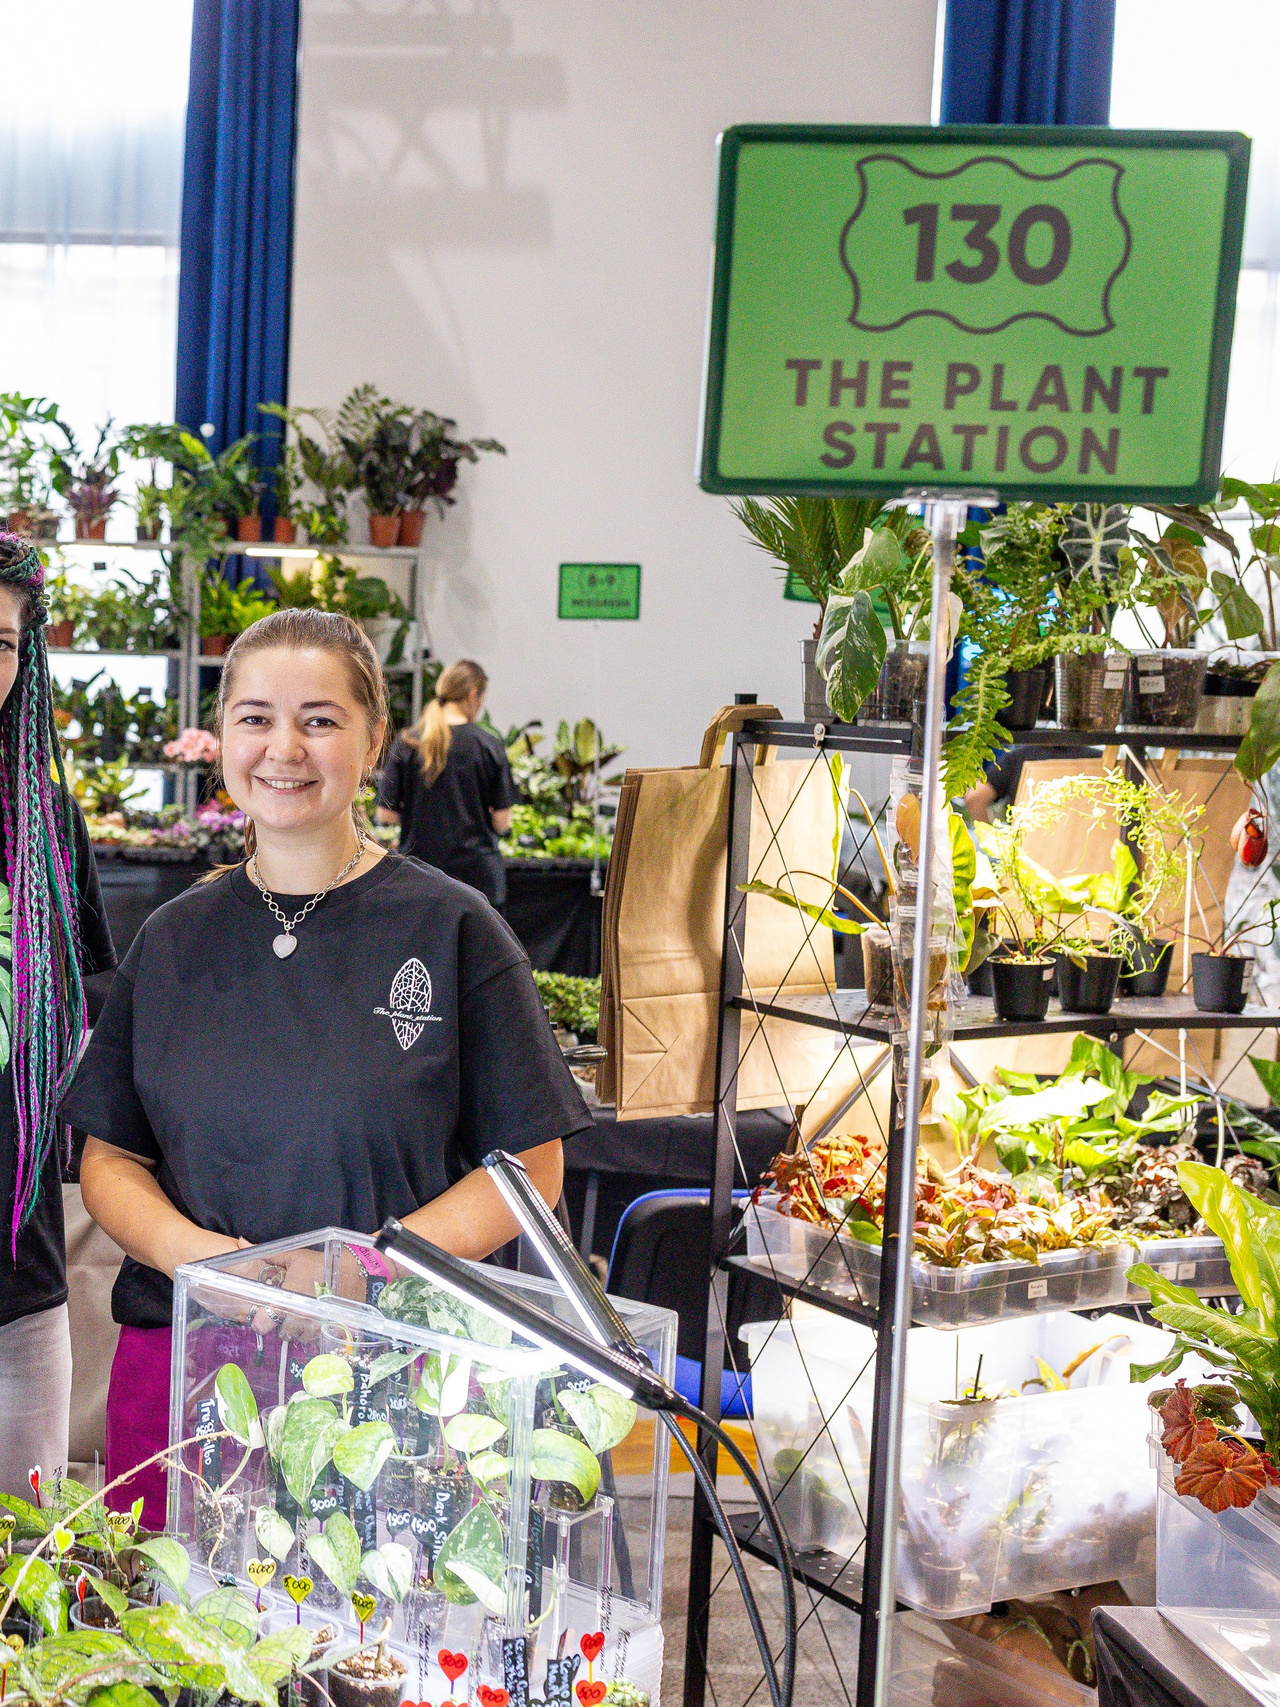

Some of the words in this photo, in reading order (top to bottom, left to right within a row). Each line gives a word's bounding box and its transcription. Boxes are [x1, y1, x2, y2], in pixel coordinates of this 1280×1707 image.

[902, 203, 1072, 285] 130
[785, 358, 914, 408] THE
[943, 362, 1170, 414] PLANT
[820, 421, 1120, 475] STATION
[310, 1496, 337, 1512] 3000
[440, 1657, 465, 1669] 500
[579, 1687, 601, 1701] 500
